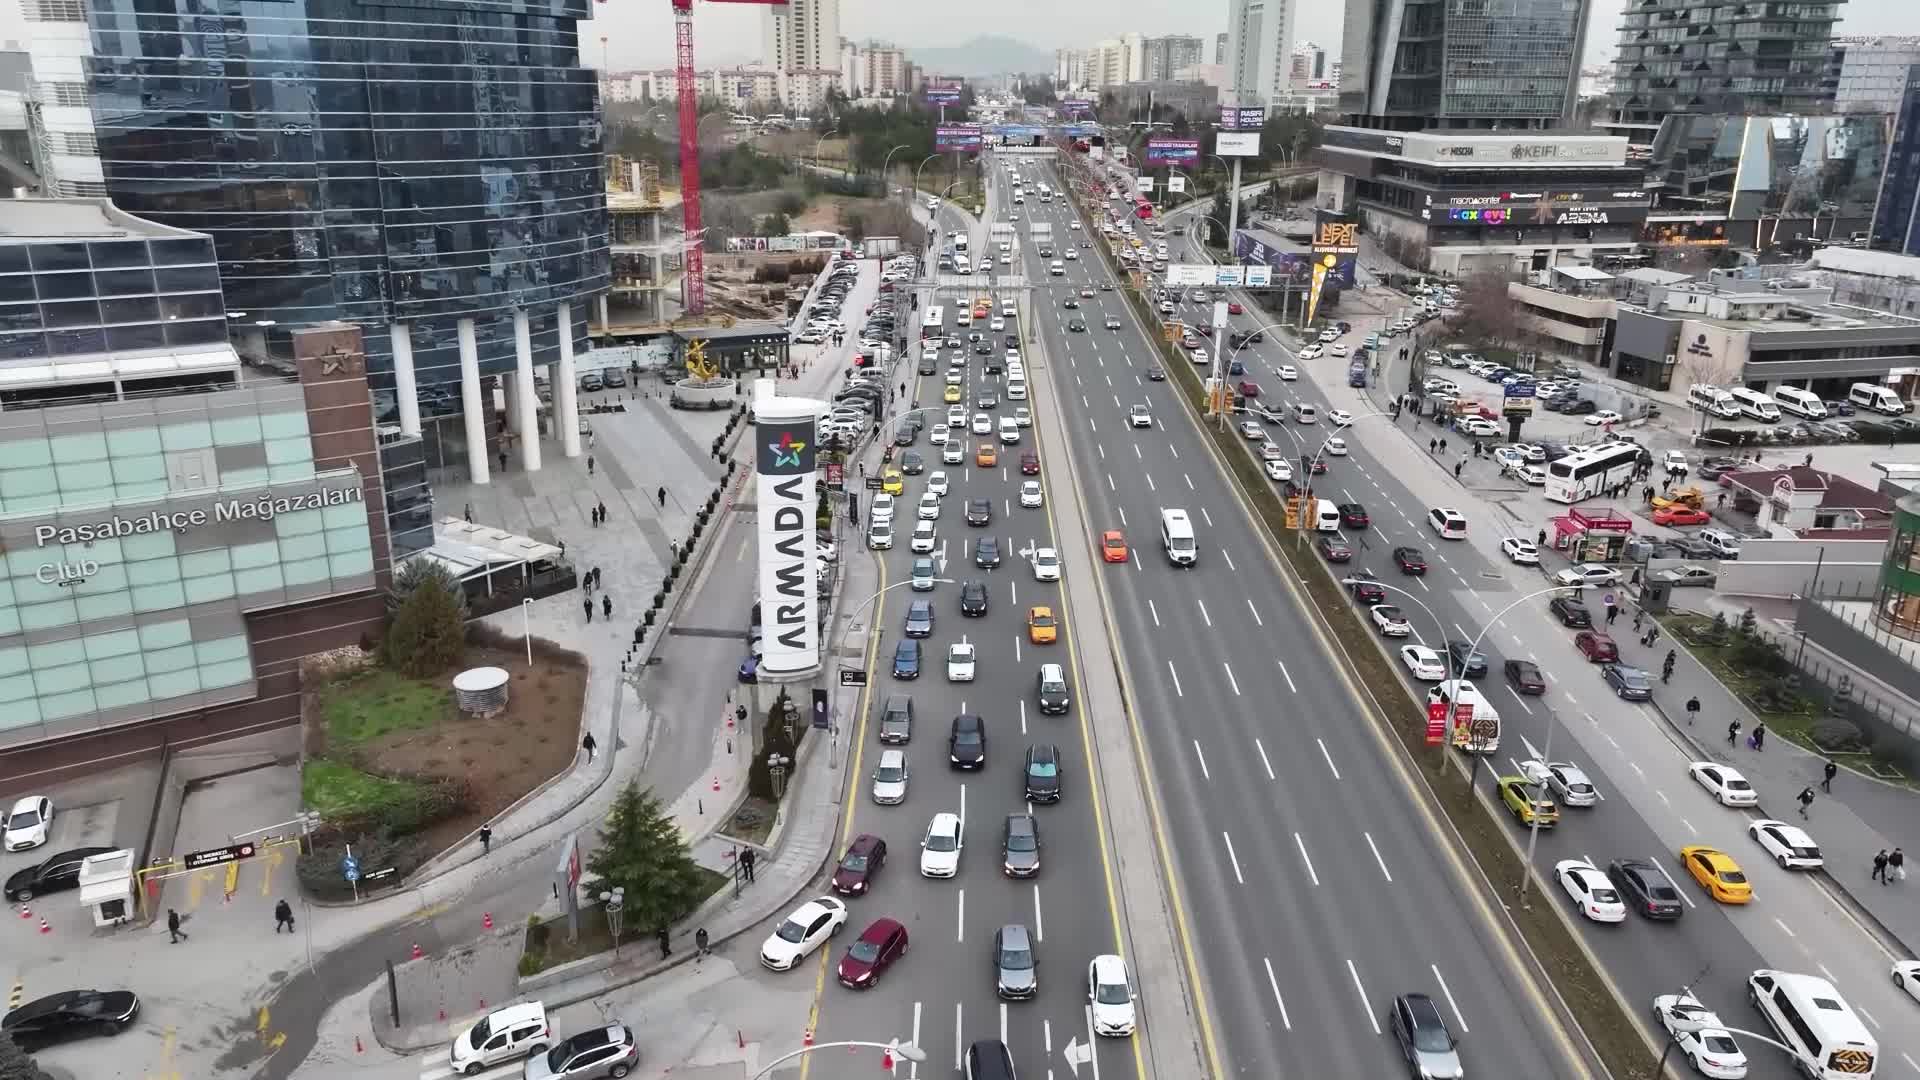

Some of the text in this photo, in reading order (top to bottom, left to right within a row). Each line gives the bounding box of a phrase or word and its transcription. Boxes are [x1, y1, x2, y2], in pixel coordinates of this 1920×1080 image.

[1557, 212, 1609, 224] ARENA
[1322, 223, 1358, 235] NEXT
[1312, 233, 1358, 245] LEVEL
[35, 487, 362, 548] Paşabahçe Mağazaları
[36, 558, 98, 584] Club
[774, 476, 805, 649] ARMADA
